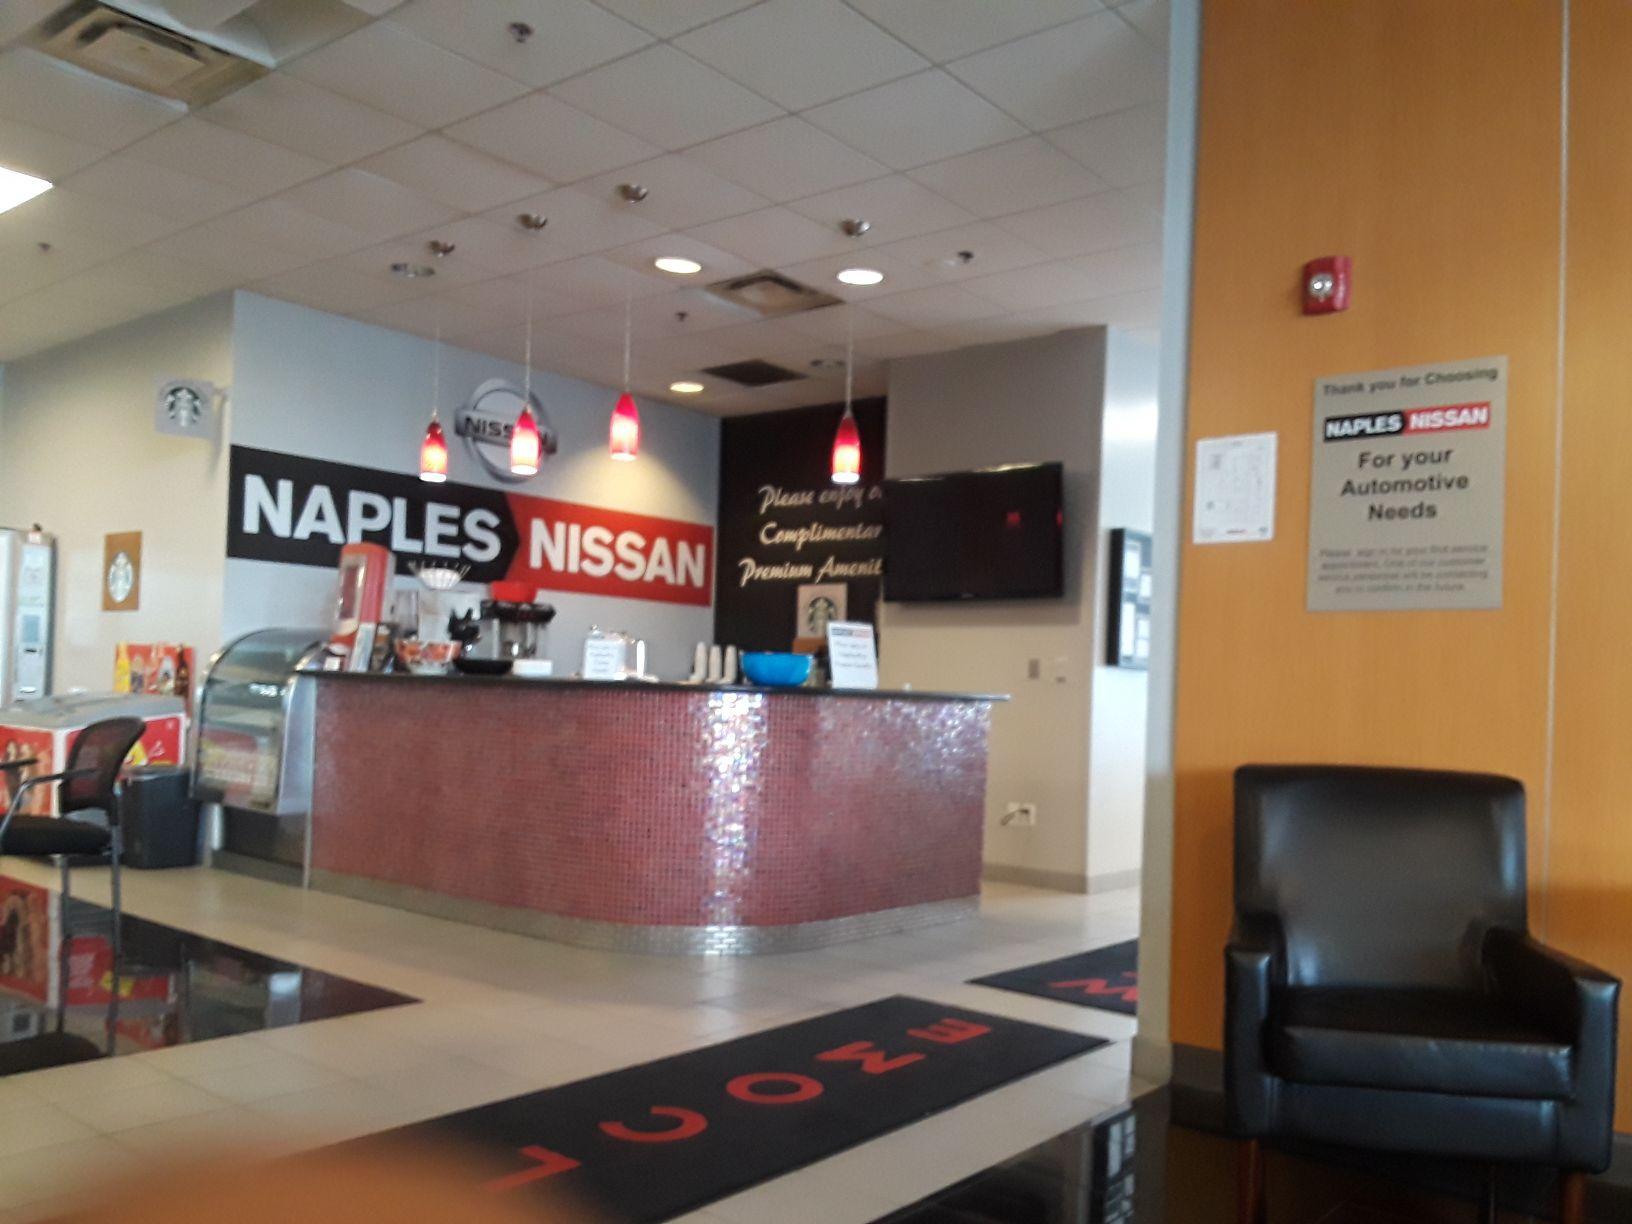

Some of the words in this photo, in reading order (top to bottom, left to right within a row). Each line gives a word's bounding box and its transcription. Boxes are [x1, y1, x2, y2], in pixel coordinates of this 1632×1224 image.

[1323, 382, 1365, 396] Thank
[1369, 381, 1396, 394] you
[1401, 375, 1419, 388] for
[1424, 367, 1498, 385] Choosing
[1325, 413, 1403, 438] NAPLES
[1409, 406, 1489, 430] NISSAN
[1358, 452, 1395, 469] For
[1402, 449, 1454, 471] your
[758, 484, 816, 515] Please
[818, 483, 865, 509] enjoy
[1340, 473, 1469, 497] Automotive
[1368, 501, 1438, 522] Needs
[243, 473, 501, 564] NAPLES
[529, 517, 706, 588] NISSAN
[738, 556, 814, 588] Premium
